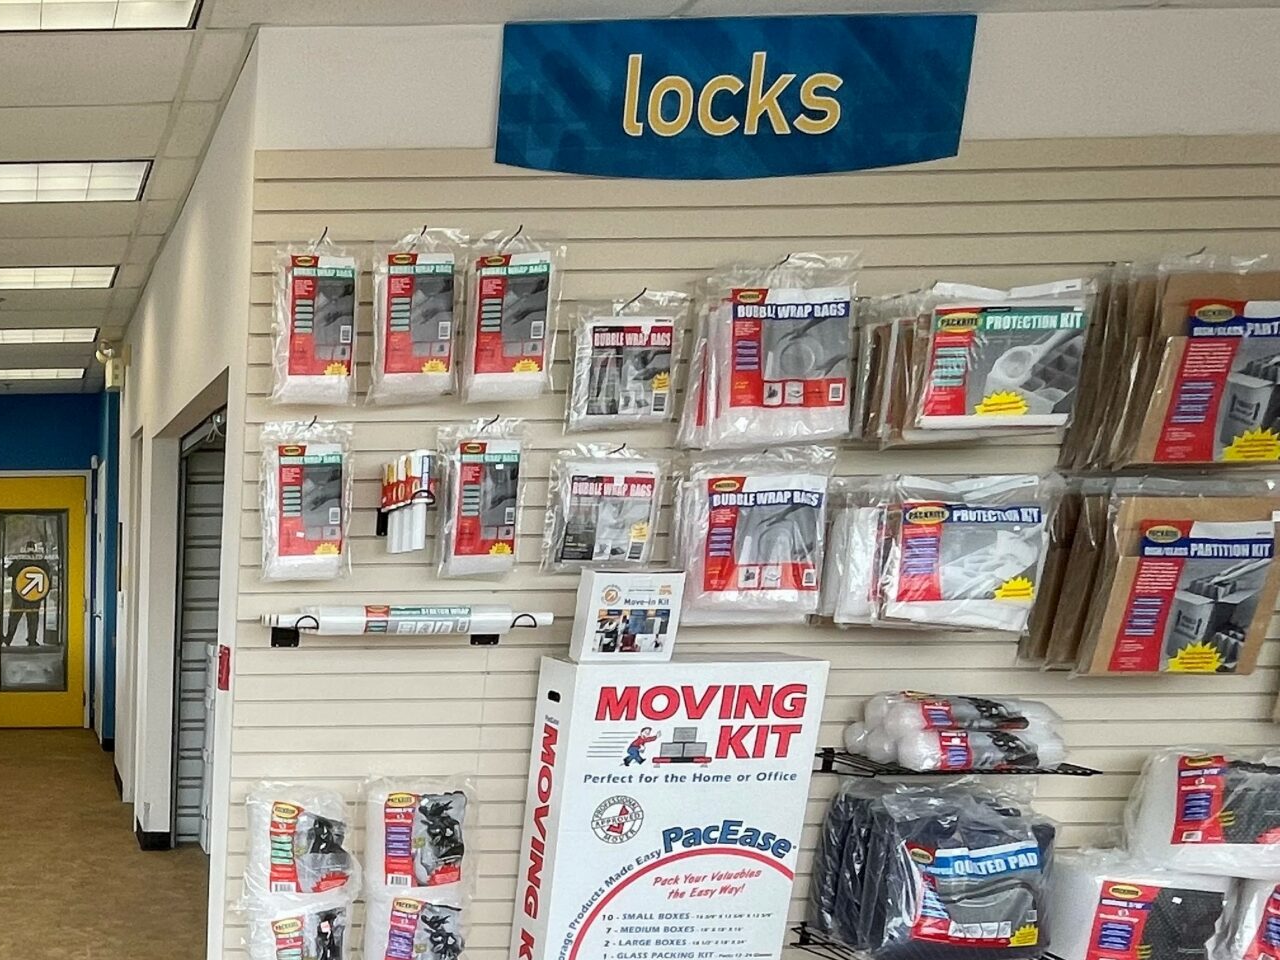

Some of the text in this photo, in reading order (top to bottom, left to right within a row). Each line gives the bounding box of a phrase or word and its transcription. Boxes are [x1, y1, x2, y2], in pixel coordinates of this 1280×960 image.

[623, 52, 843, 137] locks
[778, 304, 812, 318] WRAP
[814, 303, 845, 317] BAGS
[986, 312, 1083, 330] PROTECTION KIT
[594, 332, 671, 347] BUBBLE WRAP BAGS
[573, 482, 602, 495] BUBBLE
[630, 483, 652, 496] BAGS
[713, 491, 819, 506] BUBBLE WRAP BAGS
[953, 508, 1040, 522] PROTECTION KIT
[1190, 543, 1249, 557] PARTITION
[1251, 544, 1271, 557] KIT
[595, 683, 808, 721] MOVING
[715, 723, 803, 760] KIT
[583, 771, 798, 784] Perfect for the Home or Office
[523, 723, 558, 920] MOVING
[595, 813, 641, 828] APPROVED
[603, 829, 637, 843] MOVER
[662, 819, 792, 860] PacEase
[1007, 852, 1038, 870] PAD
[652, 868, 762, 887] Pack Your Valuables
[568, 886, 605, 930] Products
[604, 862, 634, 889] Made
[635, 848, 662, 866] Easy
[666, 882, 746, 900] the Easy Way!
[622, 912, 655, 921] SMALL
[658, 912, 690, 920] BOXES
[620, 926, 661, 934] MEDIUM
[618, 939, 652, 947] LARGE
[616, 952, 648, 960] GLASS
[697, 951, 715, 959] KIT
